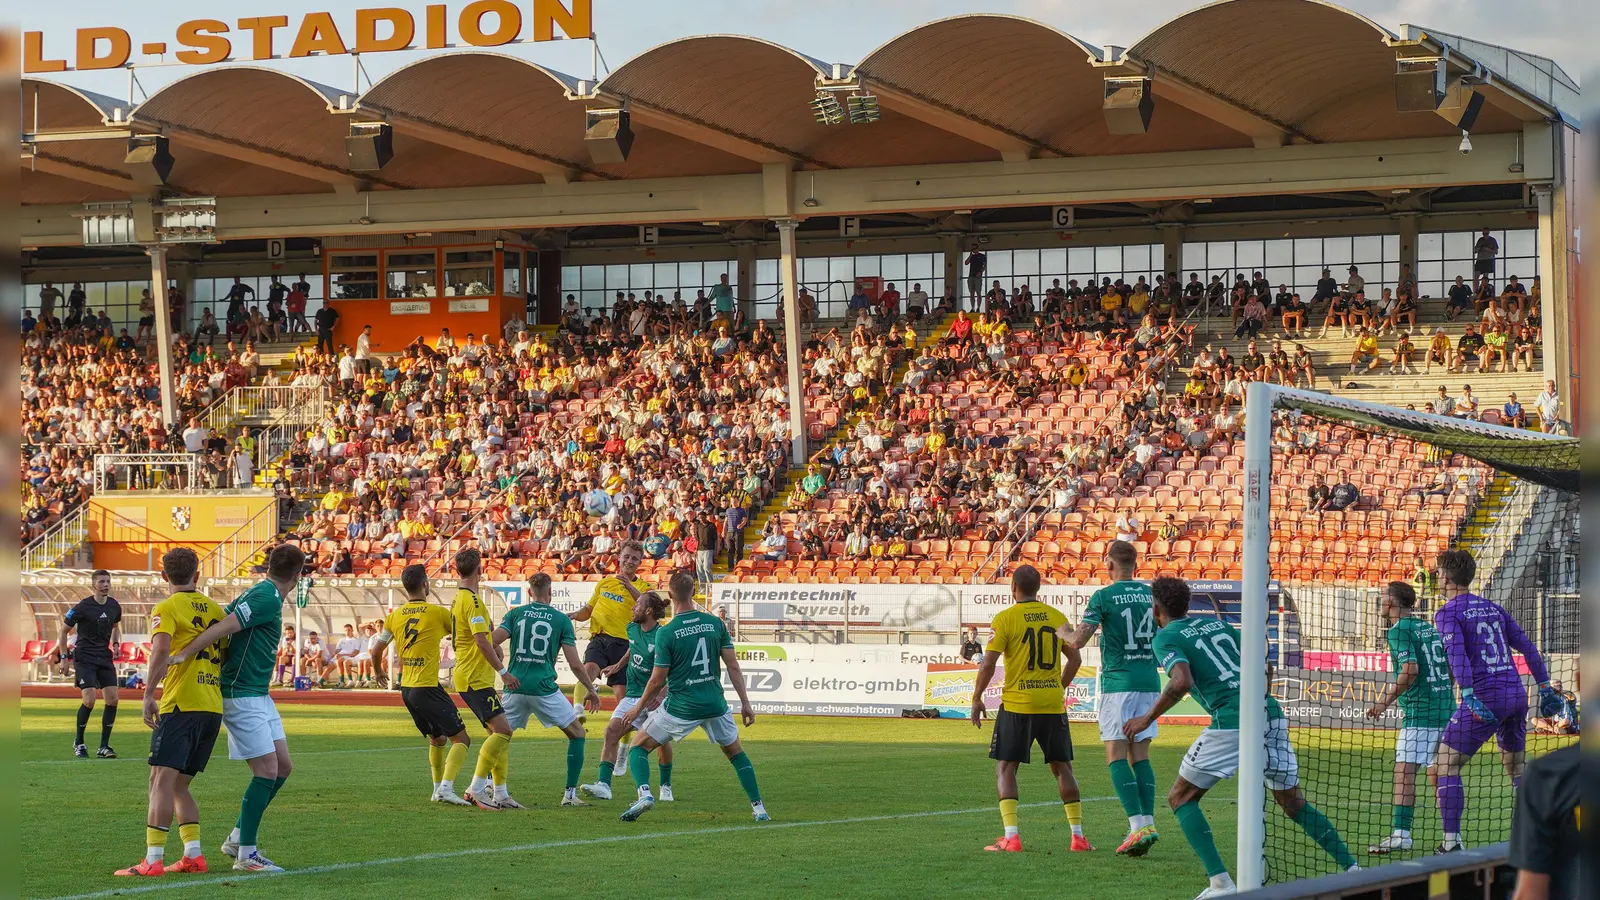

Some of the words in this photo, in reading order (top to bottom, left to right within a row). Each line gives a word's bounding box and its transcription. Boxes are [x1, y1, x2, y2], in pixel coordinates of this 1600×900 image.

[1056, 208, 1069, 226] G
[644, 226, 654, 243] E
[844, 217, 855, 236] F
[271, 240, 281, 257] D
[551, 587, 571, 597] ank
[721, 589, 857, 601] Formentechnik
[1051, 594, 1064, 605] IN
[1112, 593, 1153, 605] THOMAN
[402, 606, 428, 615] SCHWARZ
[523, 610, 553, 621] TRSLIC
[785, 604, 870, 617] Bayreuth
[1024, 612, 1049, 622] GEORGE
[674, 623, 715, 639] FRISORGER
[1120, 607, 1154, 650] 14
[516, 619, 553, 657] 18
[1476, 621, 1508, 665] 31
[691, 636, 710, 676] 4
[1021, 625, 1058, 671] 10
[1194, 632, 1241, 681] 10
[793, 677, 920, 694] elektro-gmbh
[1303, 681, 1387, 702] KREATIV
[751, 703, 805, 715] nlagenbau
[815, 704, 895, 715] schwachstrom
